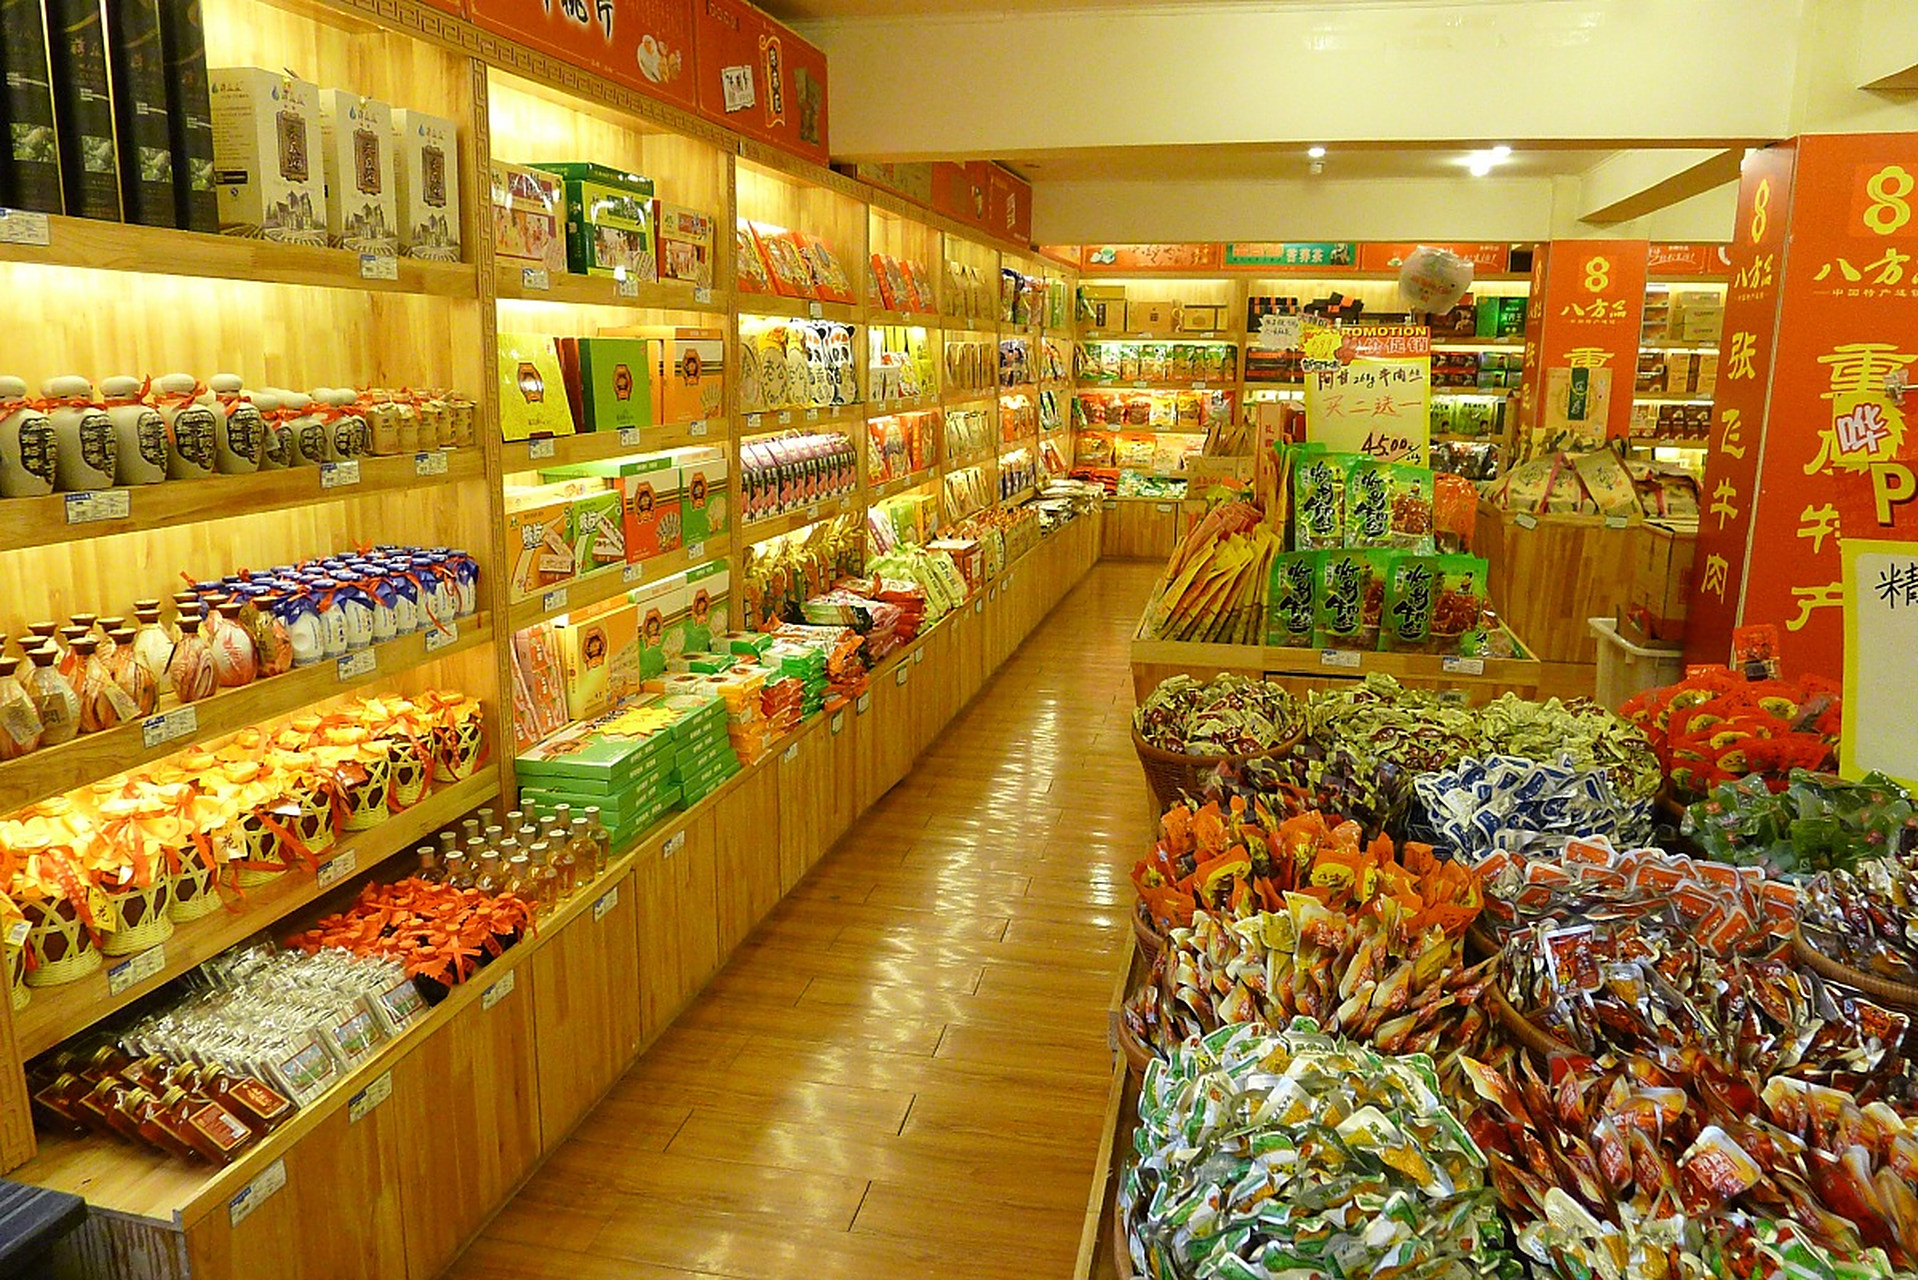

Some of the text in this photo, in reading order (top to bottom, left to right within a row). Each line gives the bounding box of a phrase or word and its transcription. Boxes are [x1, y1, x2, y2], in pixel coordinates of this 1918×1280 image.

[1863, 165, 1914, 235] 8
[1585, 256, 1610, 293] 8
[1813, 247, 1918, 285] 八方
